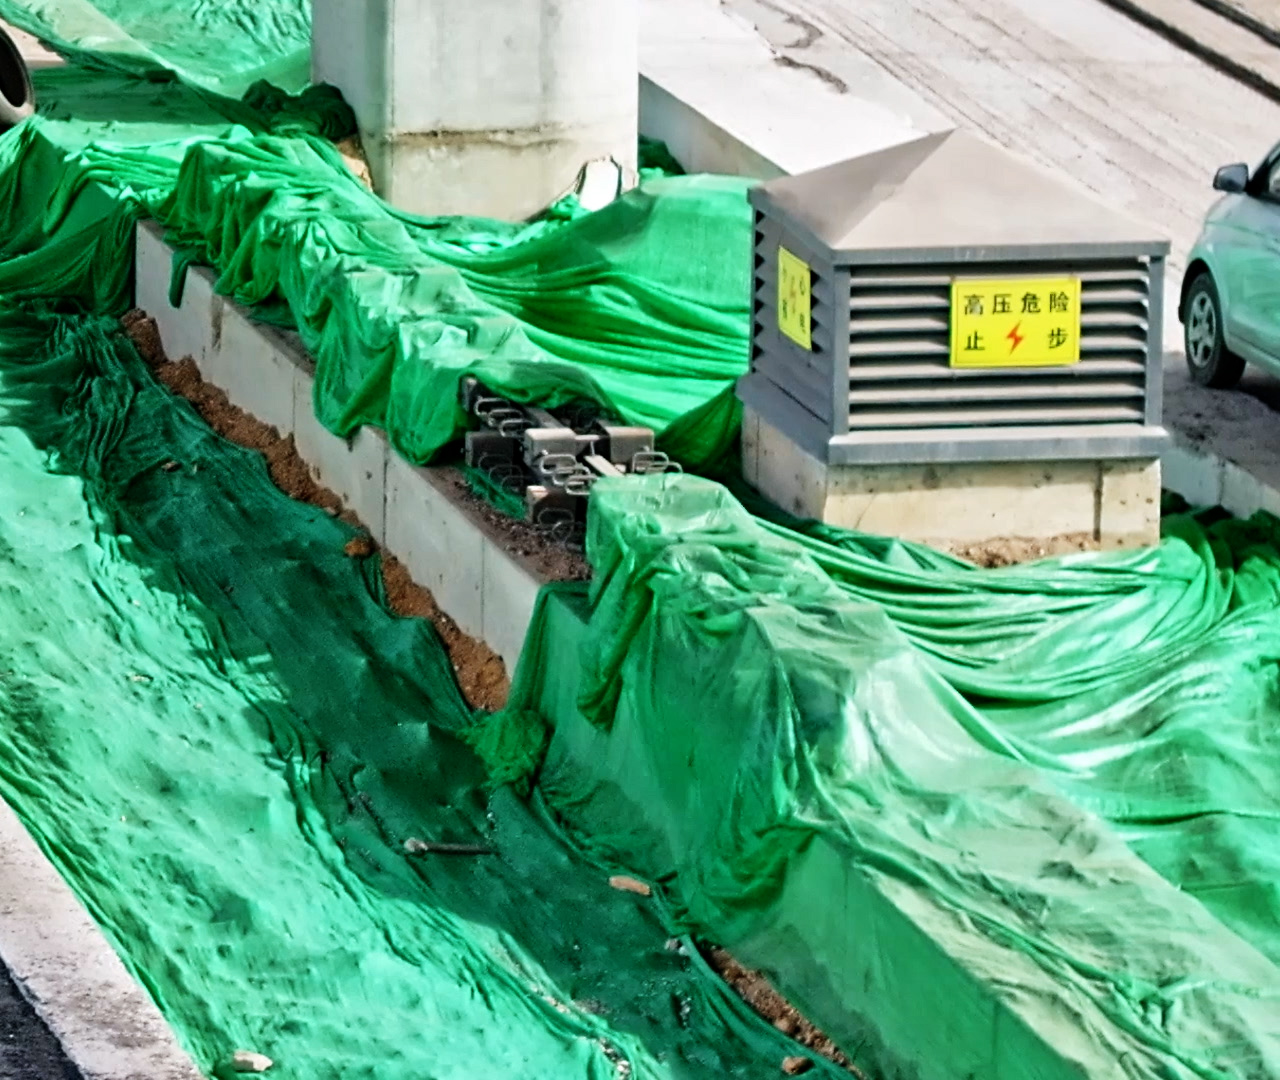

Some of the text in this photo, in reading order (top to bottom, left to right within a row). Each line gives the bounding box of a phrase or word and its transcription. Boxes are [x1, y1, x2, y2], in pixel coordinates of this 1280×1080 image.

[963, 291, 1069, 315] 高压危险
[964, 327, 1068, 350] 止 步
